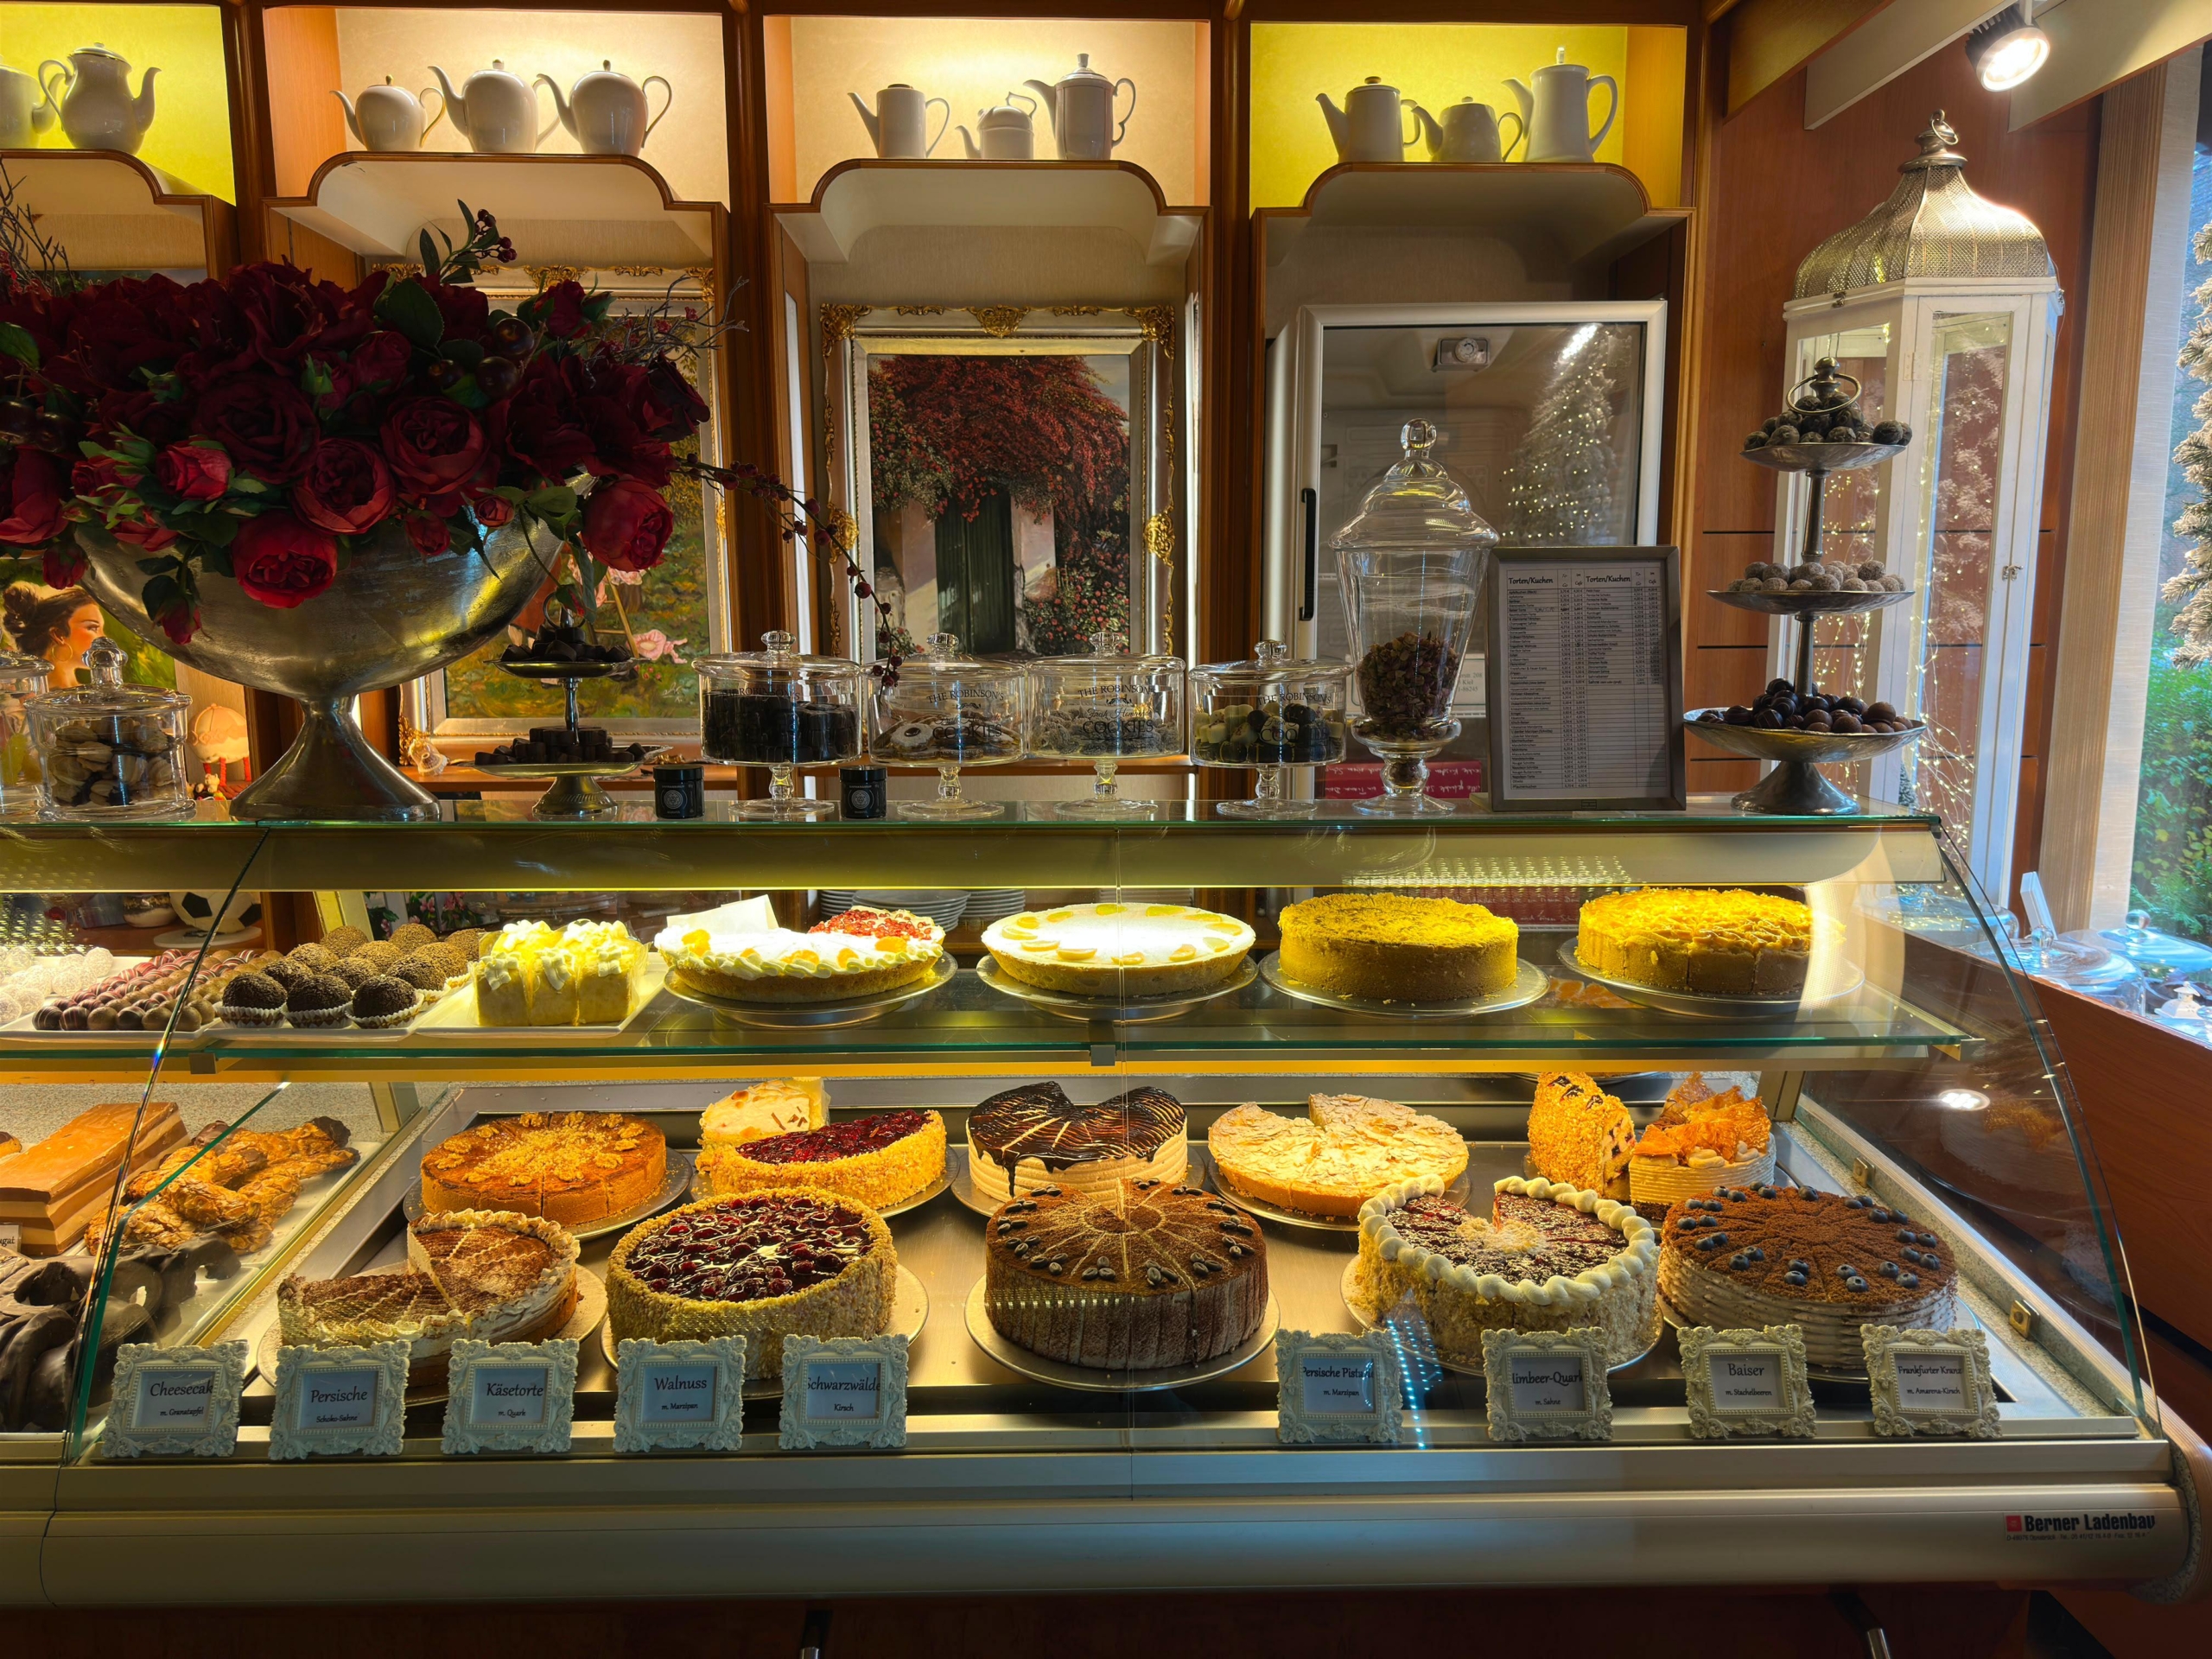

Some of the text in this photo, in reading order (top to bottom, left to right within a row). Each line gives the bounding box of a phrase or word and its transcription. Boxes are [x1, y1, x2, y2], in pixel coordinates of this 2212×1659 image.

[1509, 576, 1554, 585] Torten/Kuchen
[1586, 574, 1631, 584] Torten/Kuchen
[926, 689, 1005, 704] THE ROBINSON'S
[1077, 686, 1099, 698] THE
[932, 723, 1004, 741] COOKIES
[1083, 719, 1154, 734] COOKIES
[1303, 1365, 1340, 1378] Persische
[1727, 1363, 1764, 1376] Baiser
[1897, 1365, 1963, 1377] Frankfurter Kranz
[149, 1380, 213, 1396] Cheesecak
[654, 1375, 707, 1390] Walnuss
[310, 1385, 368, 1403] Persische
[486, 1382, 543, 1396] Käsetorte
[1332, 1389, 1359, 1398] Marzipan
[670, 1402, 698, 1411] Marzipan
[834, 1403, 854, 1412] Kirsch
[1543, 1397, 1561, 1406] Sahne
[168, 1407, 204, 1417] Granatapfel
[315, 1413, 359, 1423] Schoko-Sahne
[507, 1408, 526, 1418] Quark
[2024, 1513, 2156, 1532] Berner Ladenbau
